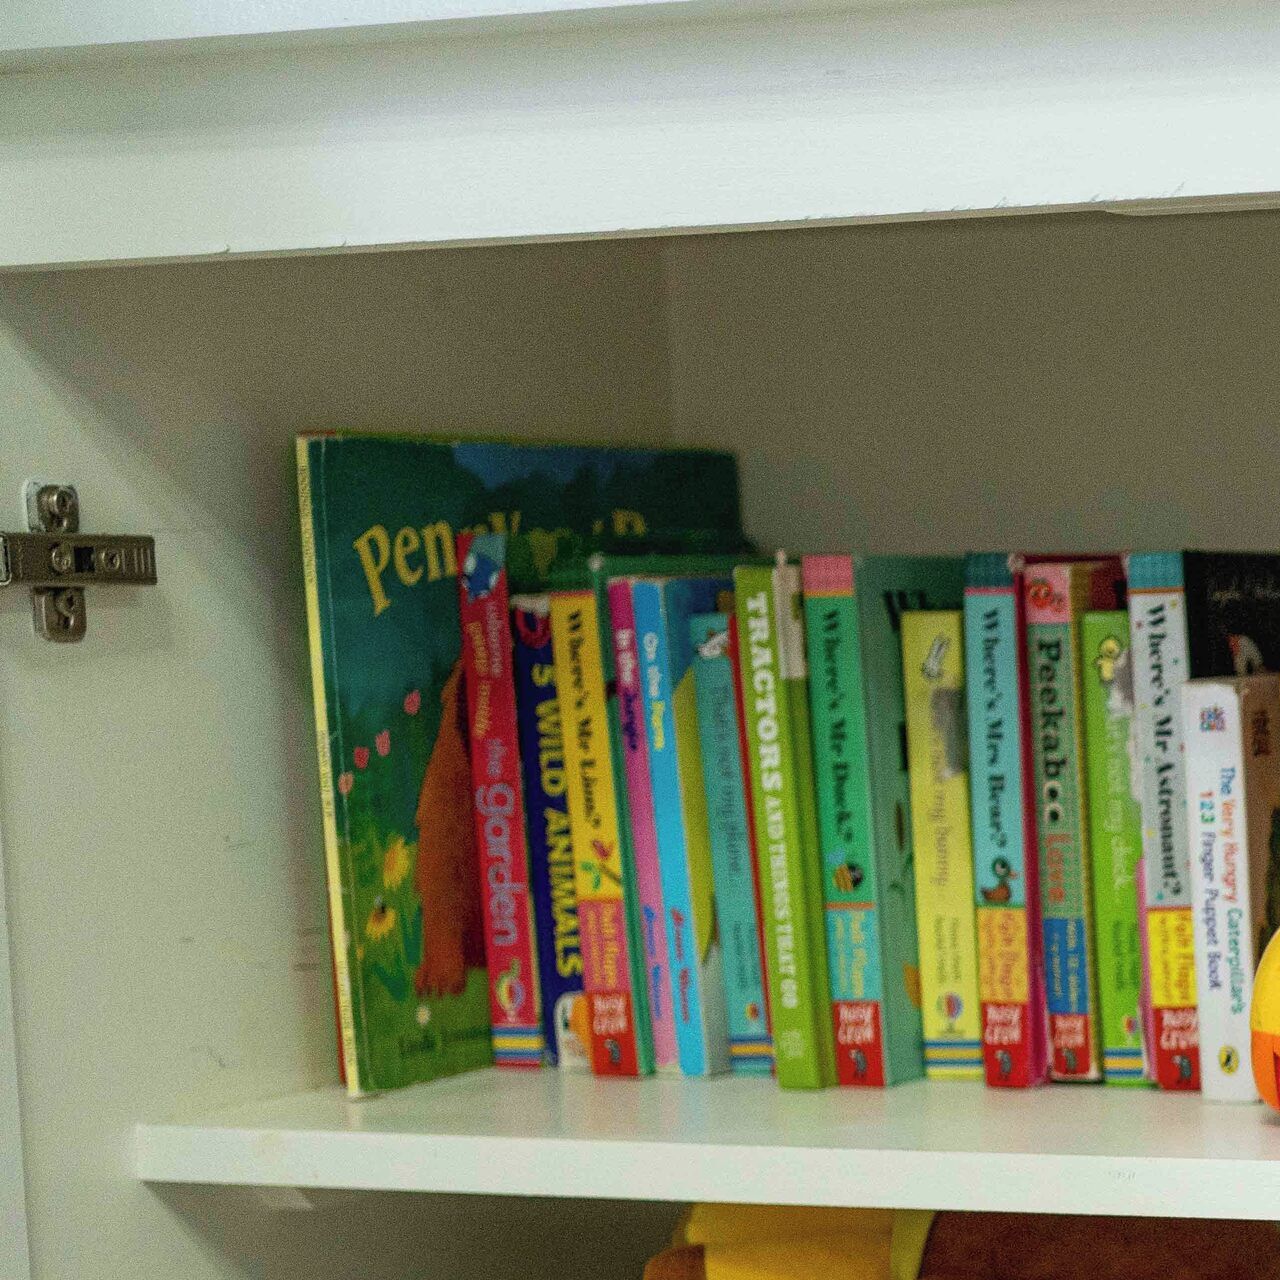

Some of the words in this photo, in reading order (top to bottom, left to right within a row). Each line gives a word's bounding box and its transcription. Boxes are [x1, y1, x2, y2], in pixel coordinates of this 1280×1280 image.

[568, 608, 591, 710] Where's
[746, 591, 784, 792] TRACTORS
[823, 609, 846, 711] Where's
[983, 607, 1003, 713] Where's
[1148, 603, 1172, 707] Where's
[536, 699, 567, 798] WILD
[578, 715, 594, 752] Mr
[830, 718, 848, 760] Mr
[985, 716, 1004, 768] Mrs
[1036, 637, 1067, 824] Peekaboo
[1156, 715, 1174, 753] Mr
[764, 796, 785, 839] AND
[833, 761, 855, 843] Duck?
[988, 773, 1008, 849] Bear?
[1220, 799, 1237, 837] Very
[1221, 766, 1237, 796] The
[476, 783, 526, 946] garden
[1156, 761, 1183, 896] Astronaut?
[1201, 831, 1217, 882] Finger
[544, 806, 585, 978] ANIMALS
[768, 843, 791, 919] THINGS
[1043, 832, 1074, 905] Love
[1221, 841, 1241, 903] Hungry
[776, 923, 797, 976] THAT
[1203, 887, 1221, 947] Puppet
[781, 979, 799, 1008] GO
[1207, 951, 1223, 991] Book
[1226, 907, 1246, 1016] Caterpillar's
